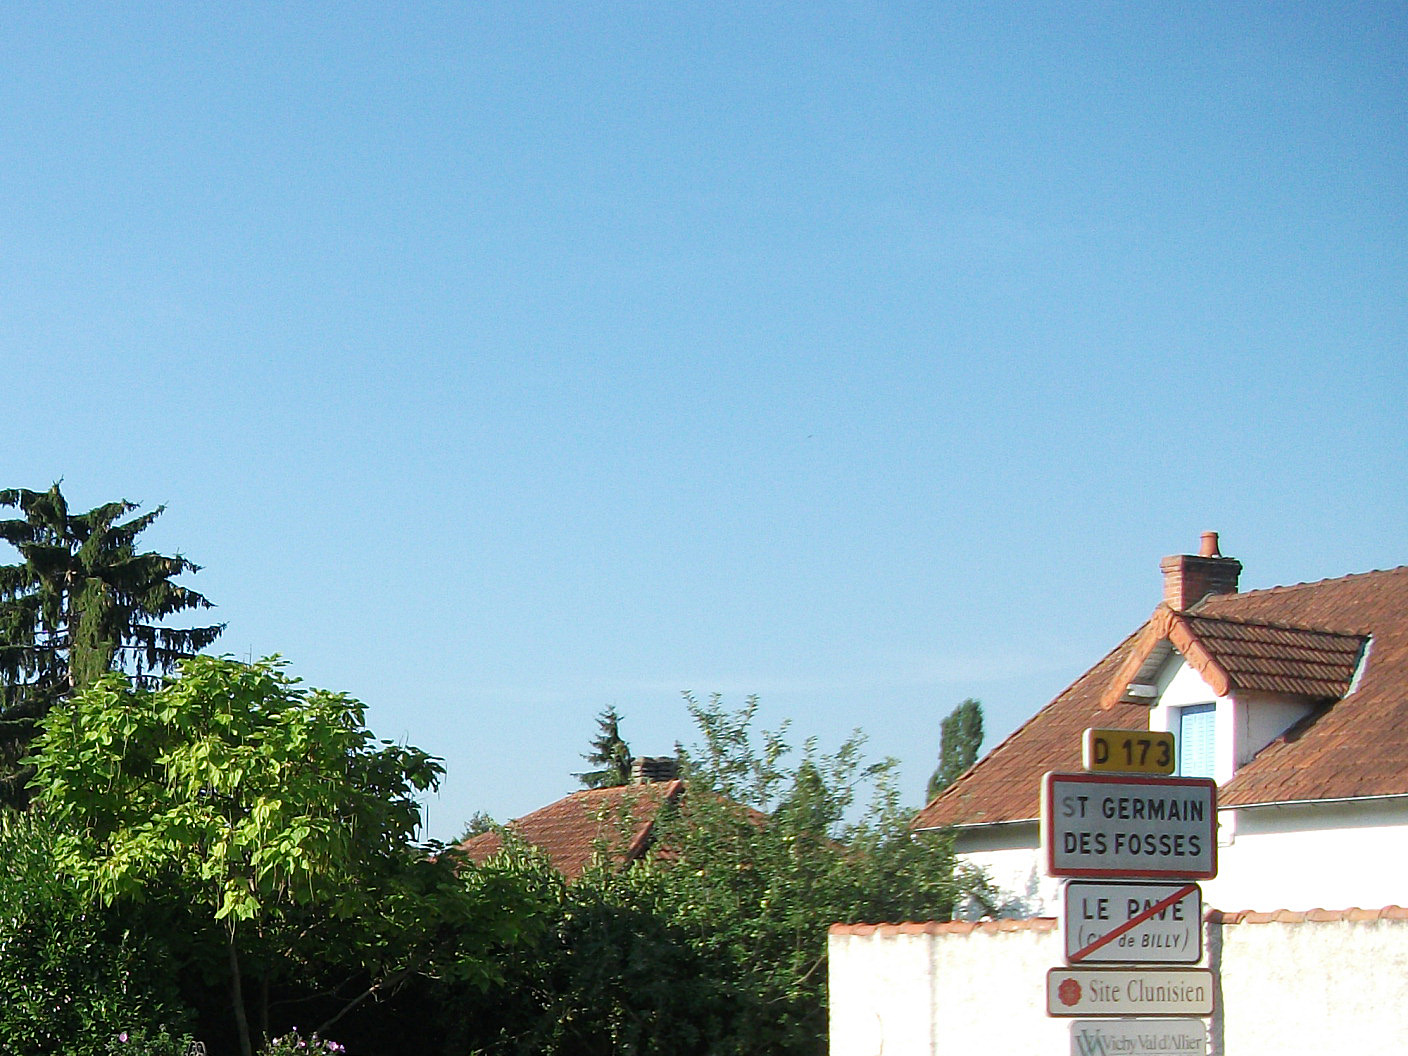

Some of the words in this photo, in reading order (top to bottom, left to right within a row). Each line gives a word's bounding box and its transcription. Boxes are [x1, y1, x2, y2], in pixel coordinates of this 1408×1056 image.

[1094, 738, 1109, 764] D
[1122, 739, 1170, 767] 173
[1062, 796, 1089, 819] ST
[1102, 797, 1203, 822] GERMAIN
[1064, 832, 1107, 855] DES
[1115, 833, 1202, 857] FOSSES
[1082, 898, 1109, 920] LE
[1118, 935, 1134, 948] de
[1141, 927, 1189, 952] BILLY)
[1089, 980, 1120, 1003] Site
[1127, 979, 1204, 1003] Clunisien
[1104, 1034, 1136, 1054] Vichy
[1138, 1035, 1157, 1050] Val
